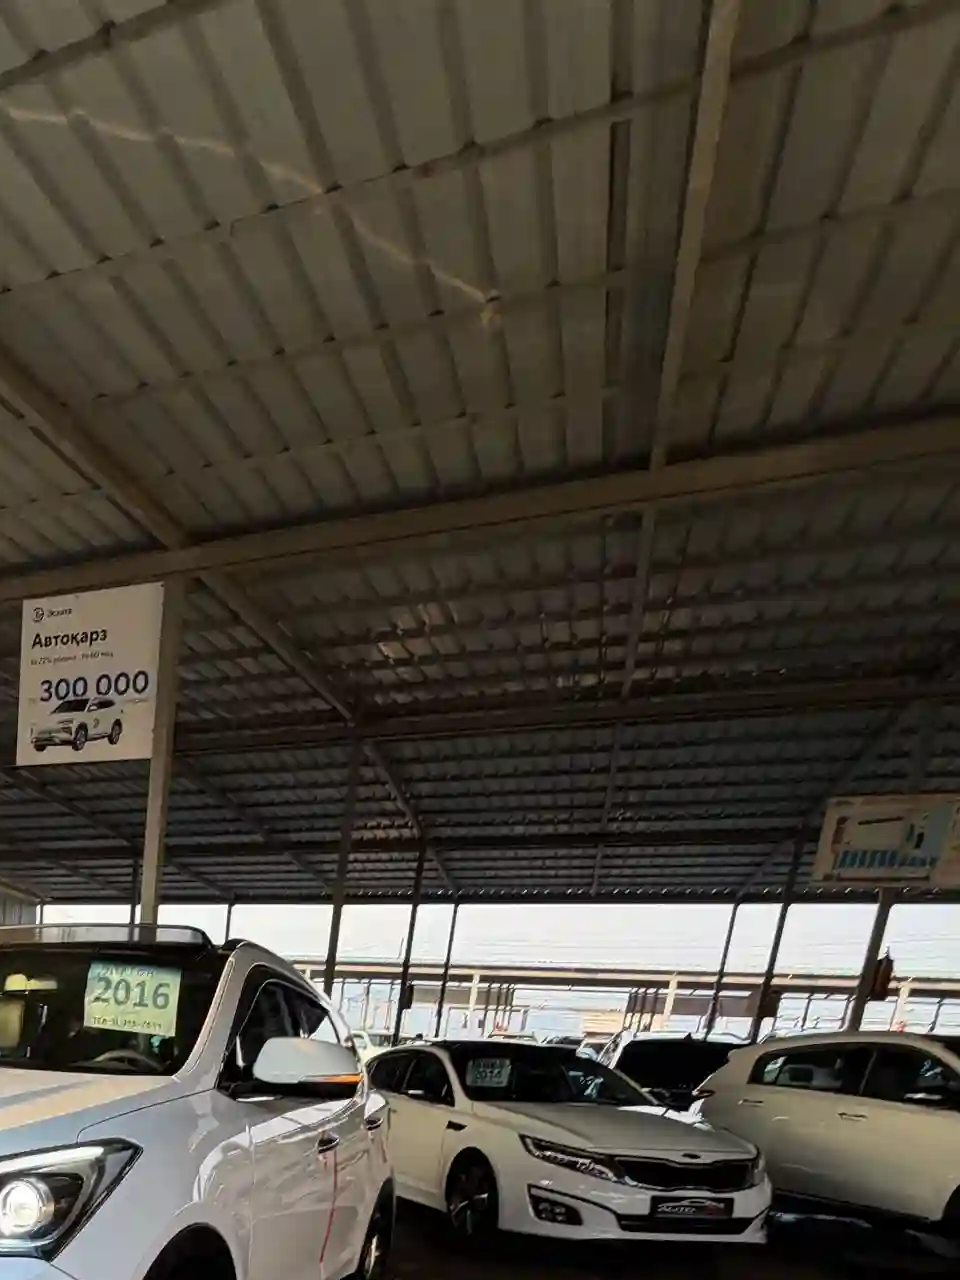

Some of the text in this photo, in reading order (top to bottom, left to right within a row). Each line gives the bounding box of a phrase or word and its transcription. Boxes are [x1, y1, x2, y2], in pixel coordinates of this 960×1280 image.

[31, 628, 108, 650] Автоқарз
[40, 669, 149, 702] 300 000
[91, 976, 171, 1010] 2016
